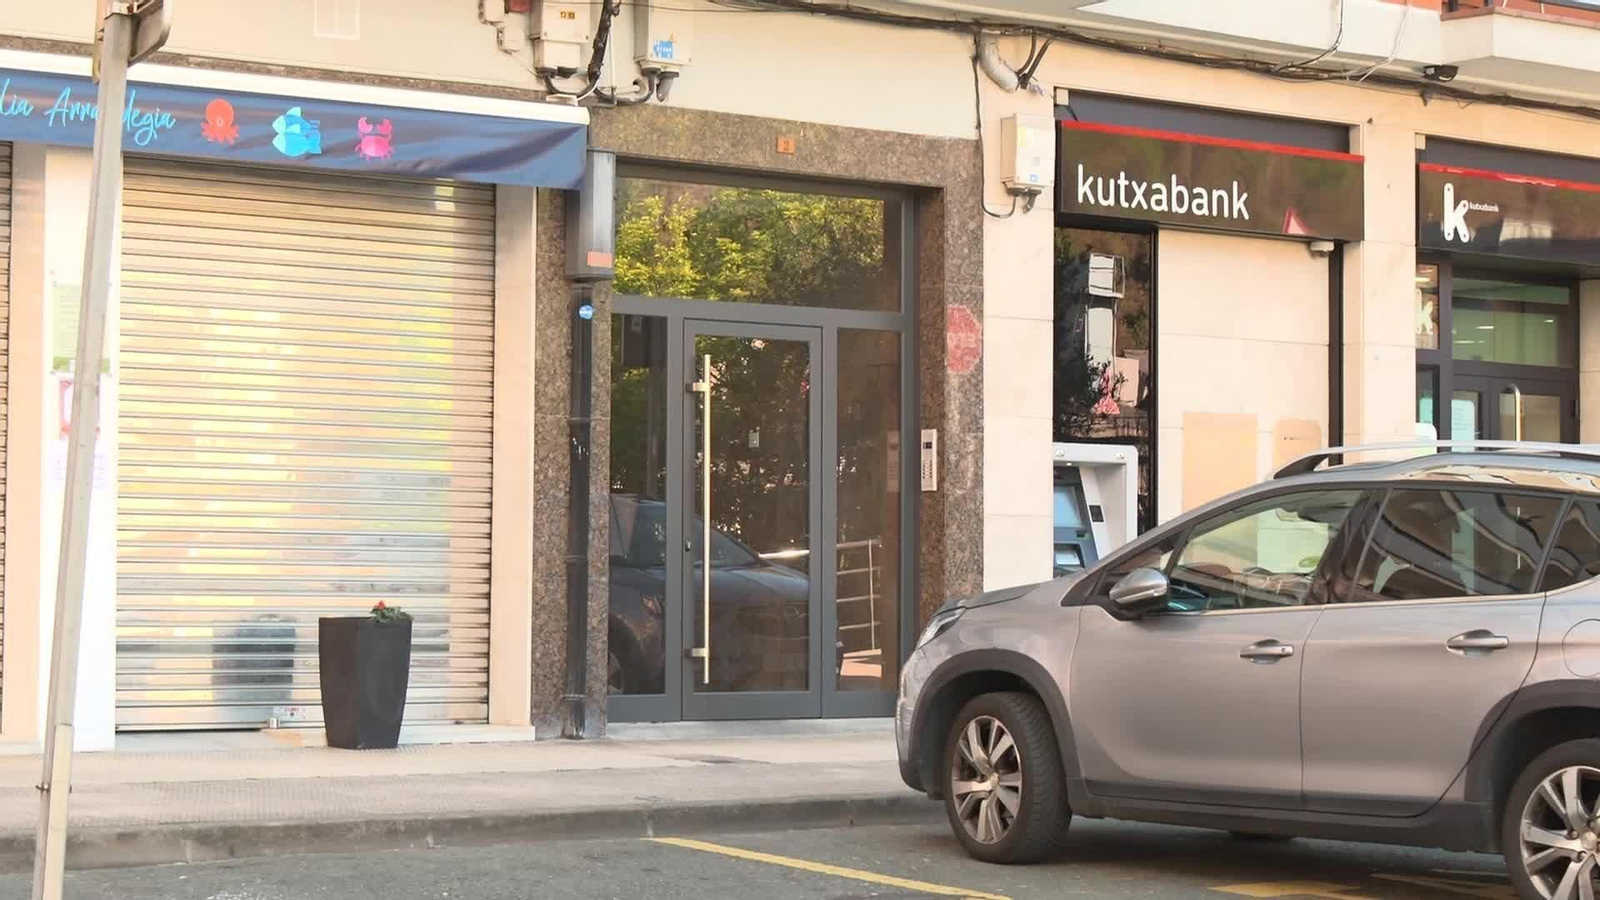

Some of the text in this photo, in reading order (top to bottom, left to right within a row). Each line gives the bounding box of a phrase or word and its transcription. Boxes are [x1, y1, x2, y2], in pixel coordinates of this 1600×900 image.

[44, 86, 177, 147] Arradegia
[1077, 163, 1250, 221] kutxabank
[1443, 182, 1470, 243] k
